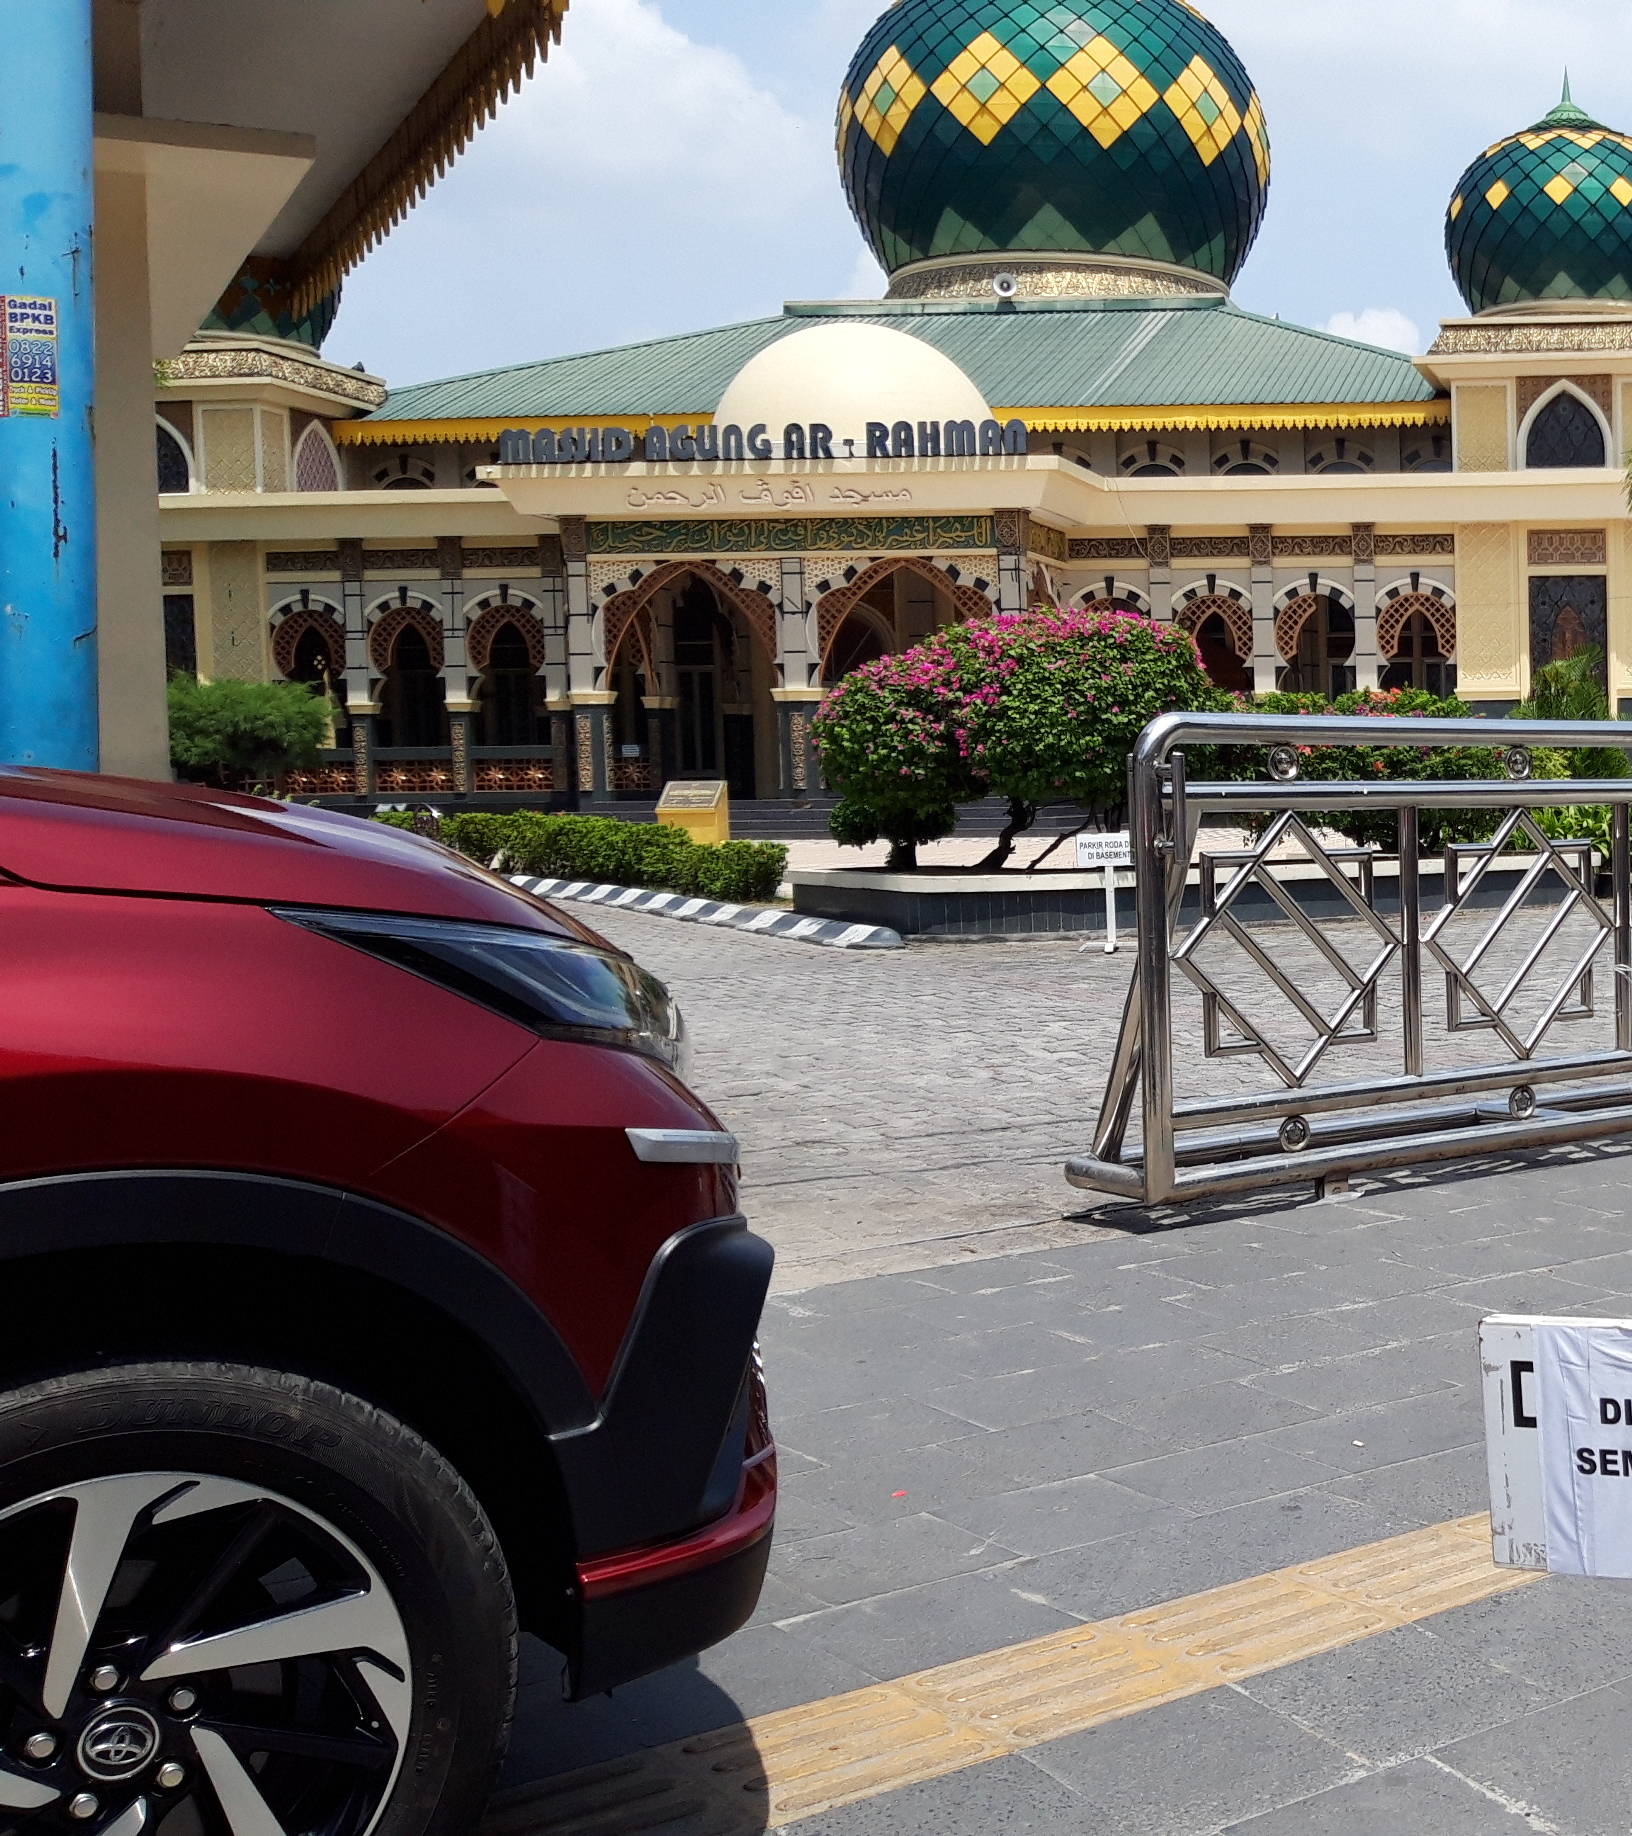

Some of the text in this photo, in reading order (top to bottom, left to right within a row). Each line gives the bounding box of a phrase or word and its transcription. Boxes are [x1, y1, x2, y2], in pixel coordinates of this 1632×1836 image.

[8, 312, 54, 325] BPKB
[9, 326, 54, 335] Express
[9, 340, 53, 355] 0822
[11, 354, 52, 368] 6914
[11, 368, 52, 382] 0123
[500, 426, 633, 464] MASJID
[645, 423, 773, 460] AGUNG
[1104, 840, 1123, 849] RODA
[1088, 852, 1095, 860] DI
[1599, 1397, 1632, 1426] DI
